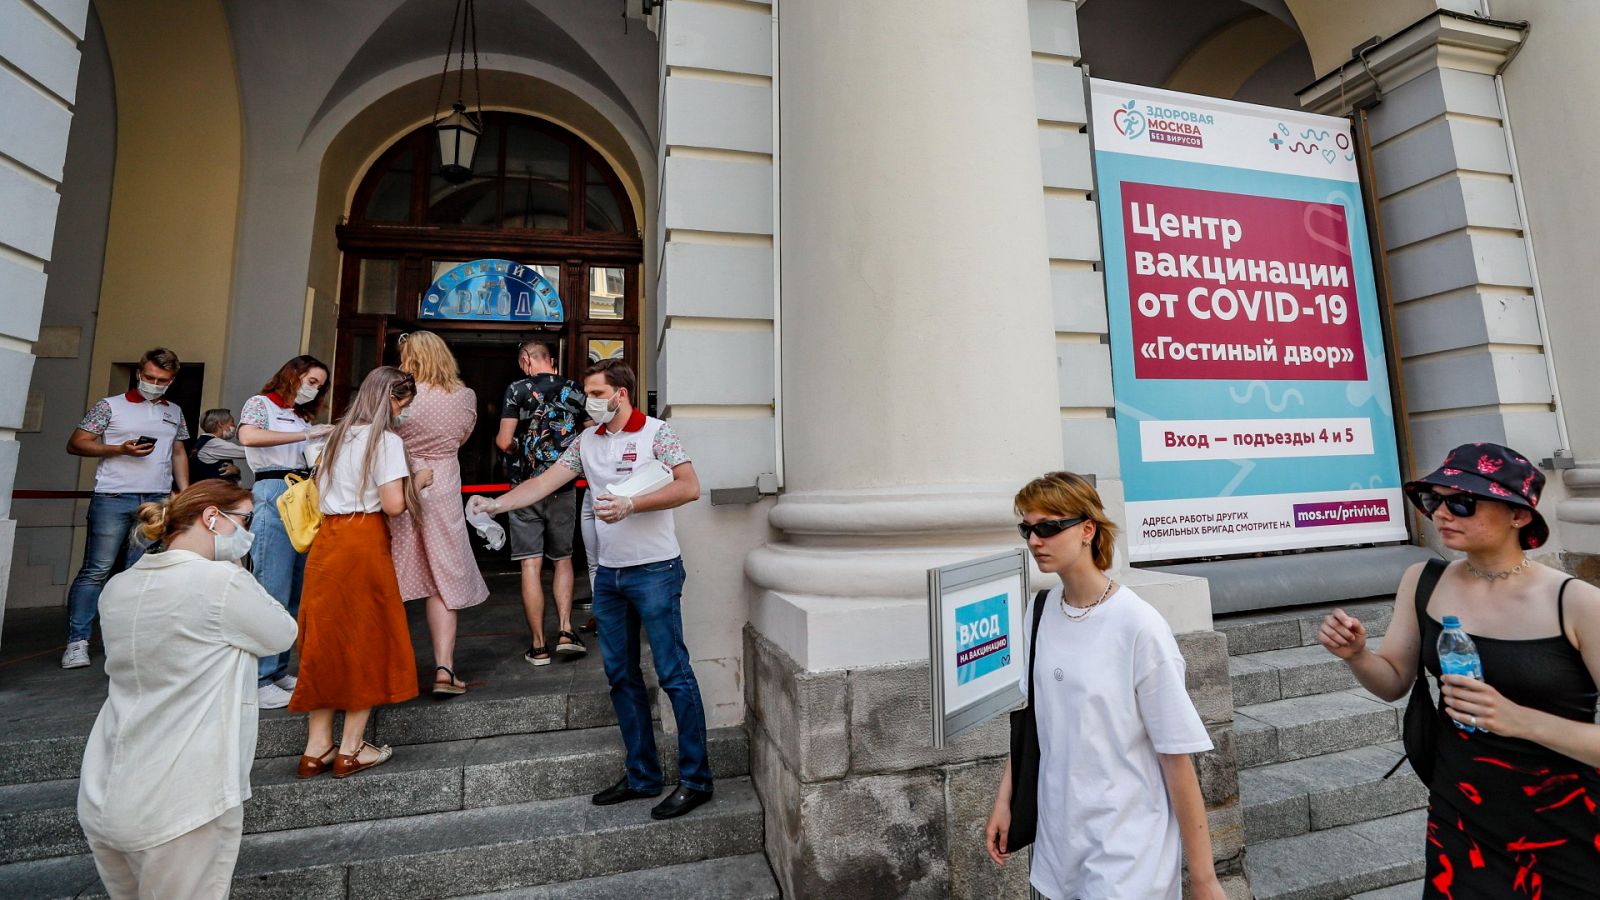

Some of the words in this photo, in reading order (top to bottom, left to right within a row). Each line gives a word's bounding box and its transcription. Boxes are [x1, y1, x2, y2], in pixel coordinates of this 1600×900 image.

[1146, 105, 1215, 125] ЗДОРОВАЯ
[1148, 118, 1202, 136] МОСКВА
[1151, 132, 1165, 141] БЕЗ
[1167, 133, 1201, 146] ВИРУСОВ
[1131, 201, 1243, 250] Центр
[1135, 251, 1349, 290] вакцинации
[424, 263, 525, 317] ГОСТИНЫЙ
[456, 290, 532, 316] ВХОД
[1137, 292, 1179, 318] от
[1187, 287, 1349, 326] COVID-19
[1140, 336, 1278, 363] «Гостиный
[1284, 347, 1355, 369] двор»
[1164, 430, 1210, 449] Вход
[1233, 431, 1315, 447] подъезды
[1319, 428, 1329, 443] 4
[1333, 431, 1342, 443] и
[1345, 427, 1354, 443] 5
[1142, 516, 1178, 526] АДРЕСА
[1179, 513, 1215, 524] РАБОТЫ
[1216, 511, 1249, 523] ДРУГИХ
[1297, 505, 1388, 522] mos.ru/privivka
[1142, 527, 1200, 538] МОБИЛЬНЫХ
[1201, 525, 1235, 535] БРИГАД
[1235, 522, 1279, 532] СМОТРИТЕ
[1279, 521, 1291, 529] НА
[959, 614, 1000, 645] ВХОД
[960, 653, 969, 663] НА
[969, 638, 1007, 660] ВАКЦИНАЦИЮ
